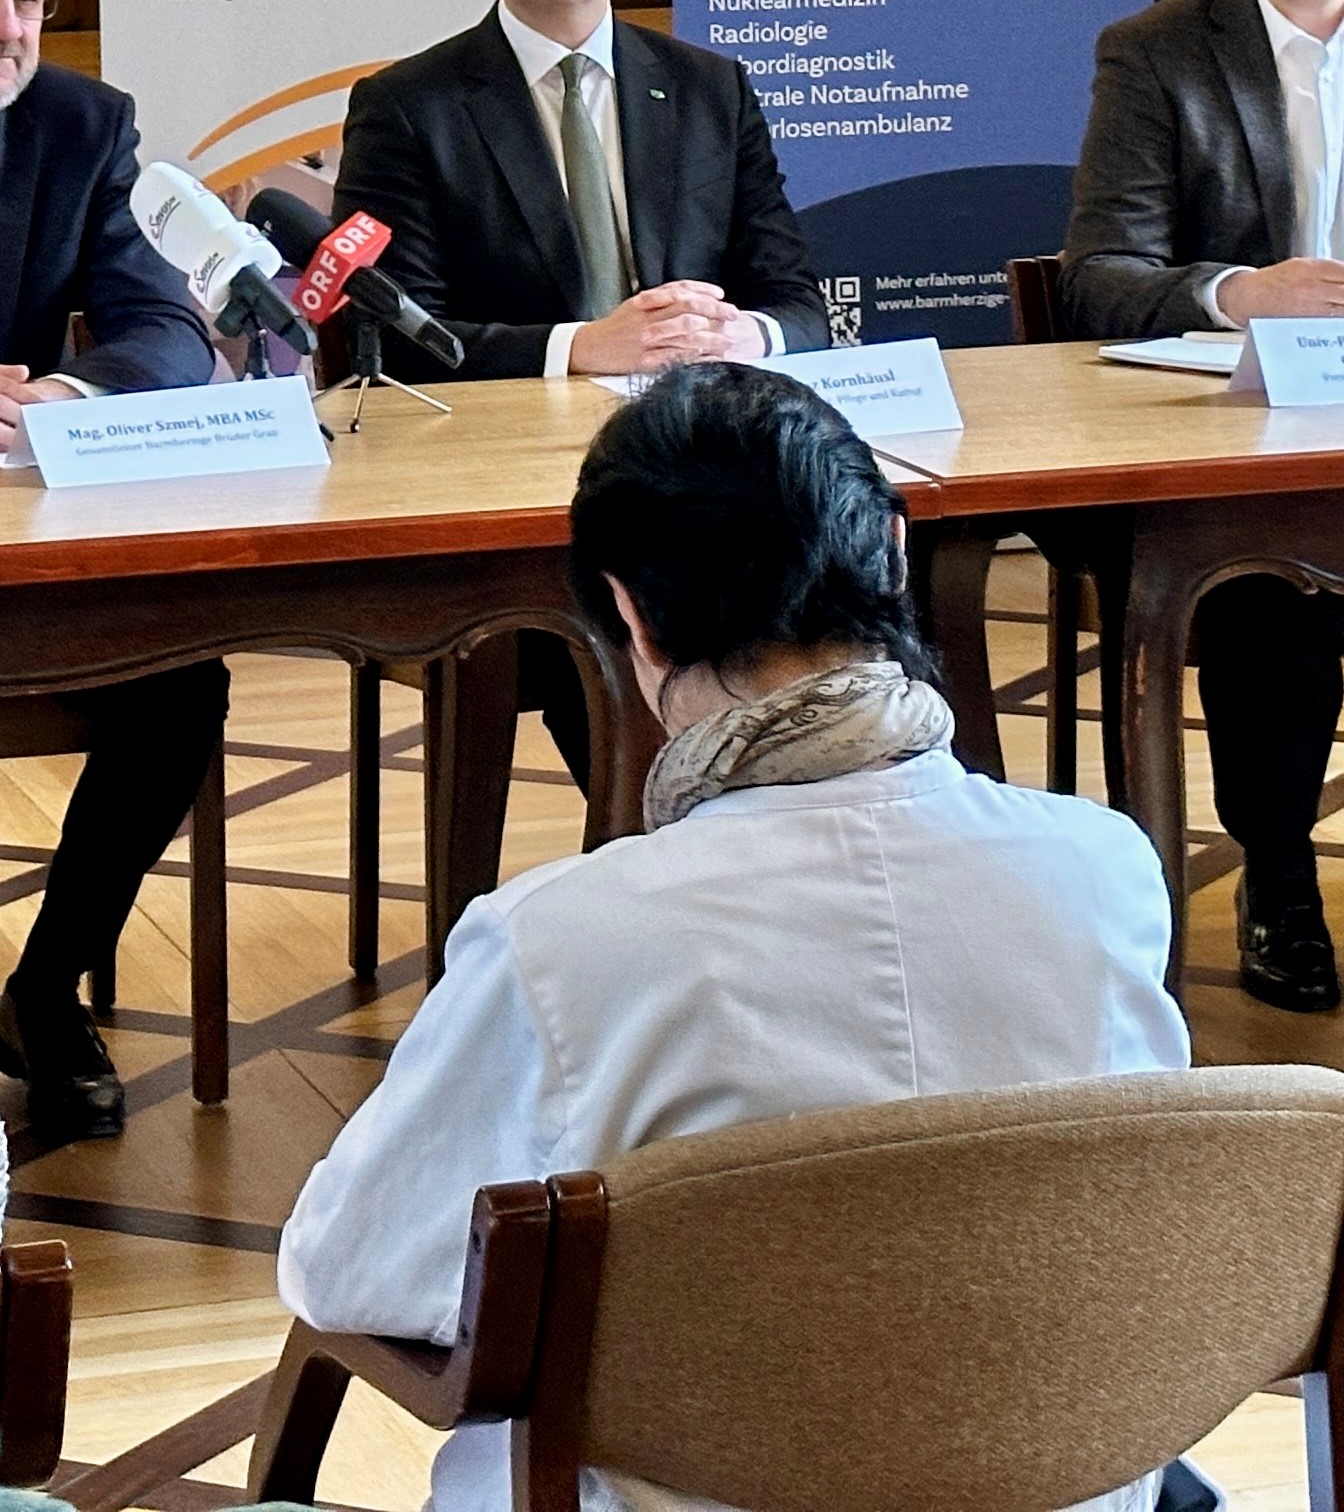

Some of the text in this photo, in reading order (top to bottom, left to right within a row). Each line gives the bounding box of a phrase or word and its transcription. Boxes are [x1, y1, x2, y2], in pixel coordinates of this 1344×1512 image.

[710, 20, 827, 46] Radiologie
[738, 49, 895, 78] bordiagnostik
[756, 80, 968, 107] trale Notaufnahme
[771, 112, 953, 139] rlosenambulanz
[334, 215, 377, 255] ORF
[301, 250, 338, 311] ORF
[876, 271, 1008, 290] Mehr erfahren unte
[67, 428, 104, 441] Mag.
[106, 422, 152, 437] Oliver
[207, 411, 242, 426] MBA
